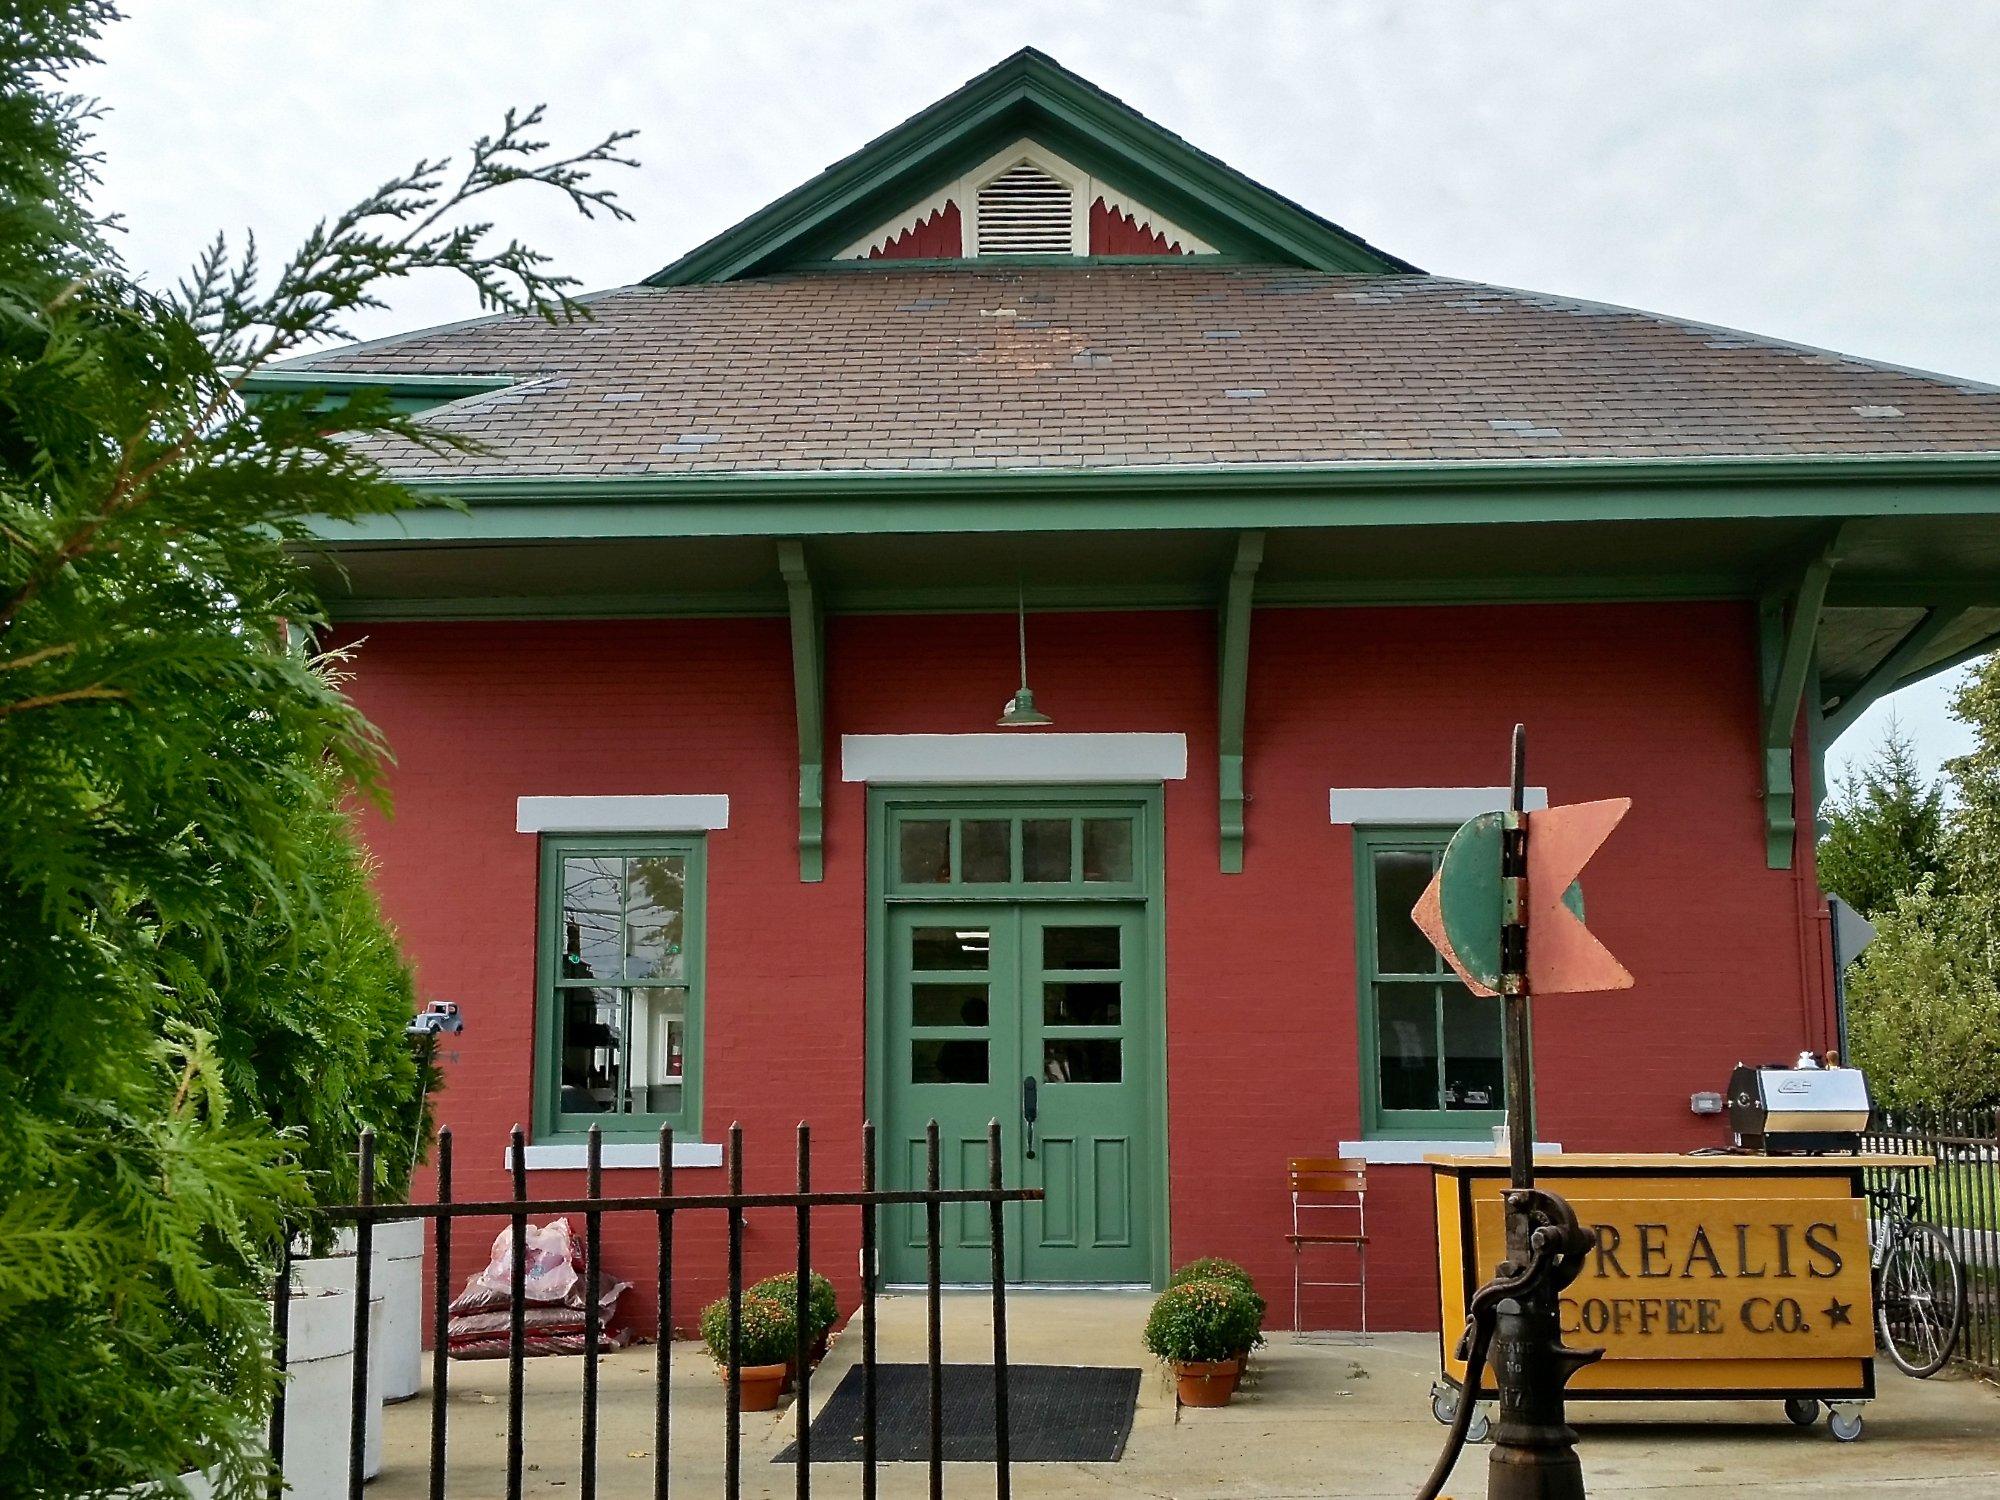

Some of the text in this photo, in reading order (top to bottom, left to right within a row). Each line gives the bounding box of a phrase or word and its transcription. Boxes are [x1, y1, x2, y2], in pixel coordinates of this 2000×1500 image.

[1591, 1222, 1843, 1279] REALIS
[1558, 1297, 1811, 1335] COFFEE CO.
